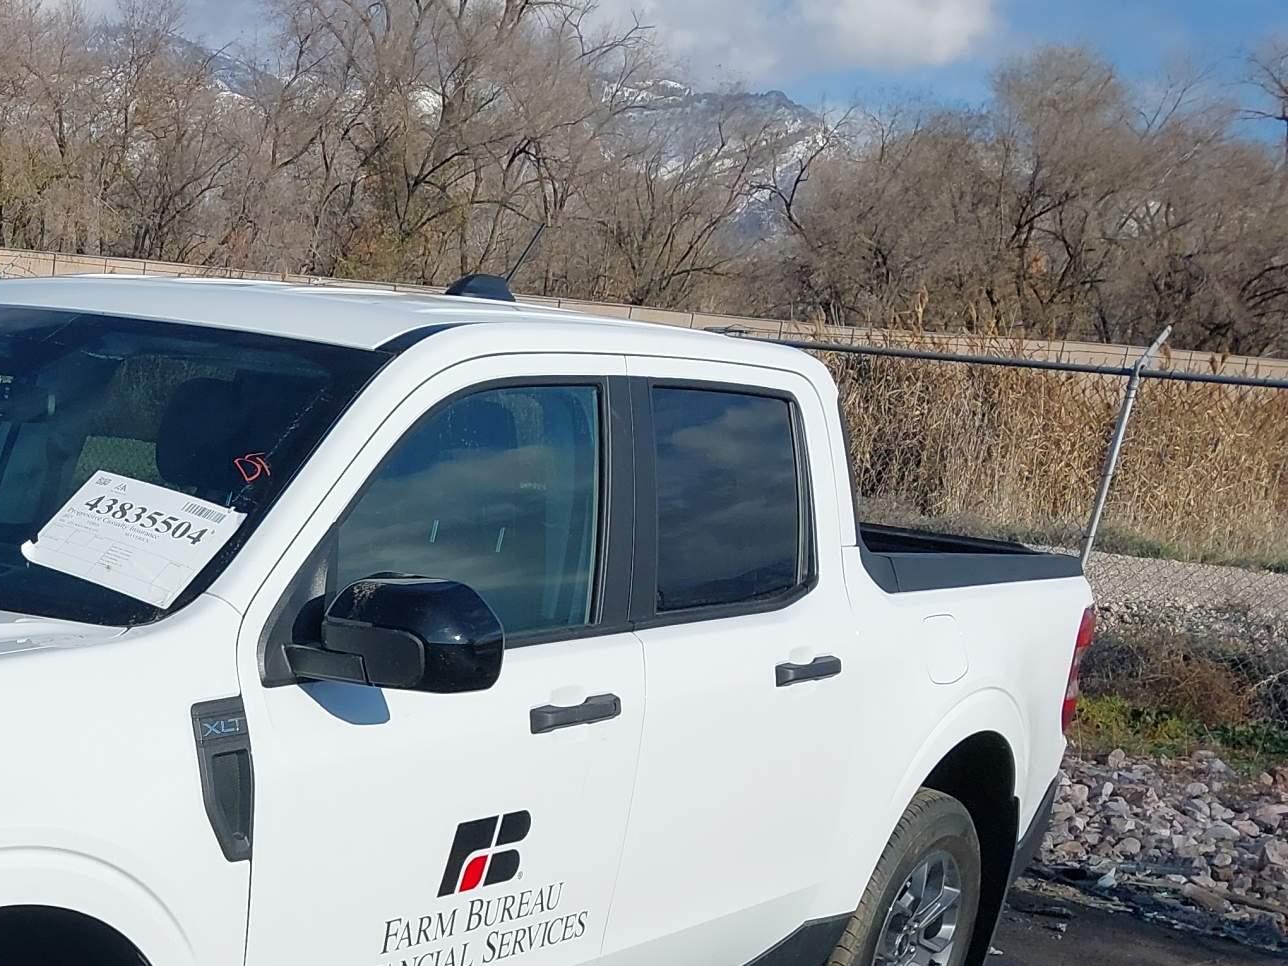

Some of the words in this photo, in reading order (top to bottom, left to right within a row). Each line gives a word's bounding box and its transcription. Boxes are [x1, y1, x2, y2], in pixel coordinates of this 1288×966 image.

[85, 495, 209, 545] 43835504
[202, 718, 246, 737] XLT
[380, 908, 459, 955] FARM
[464, 881, 565, 933] BUREAU
[482, 911, 589, 964] SERVICES
